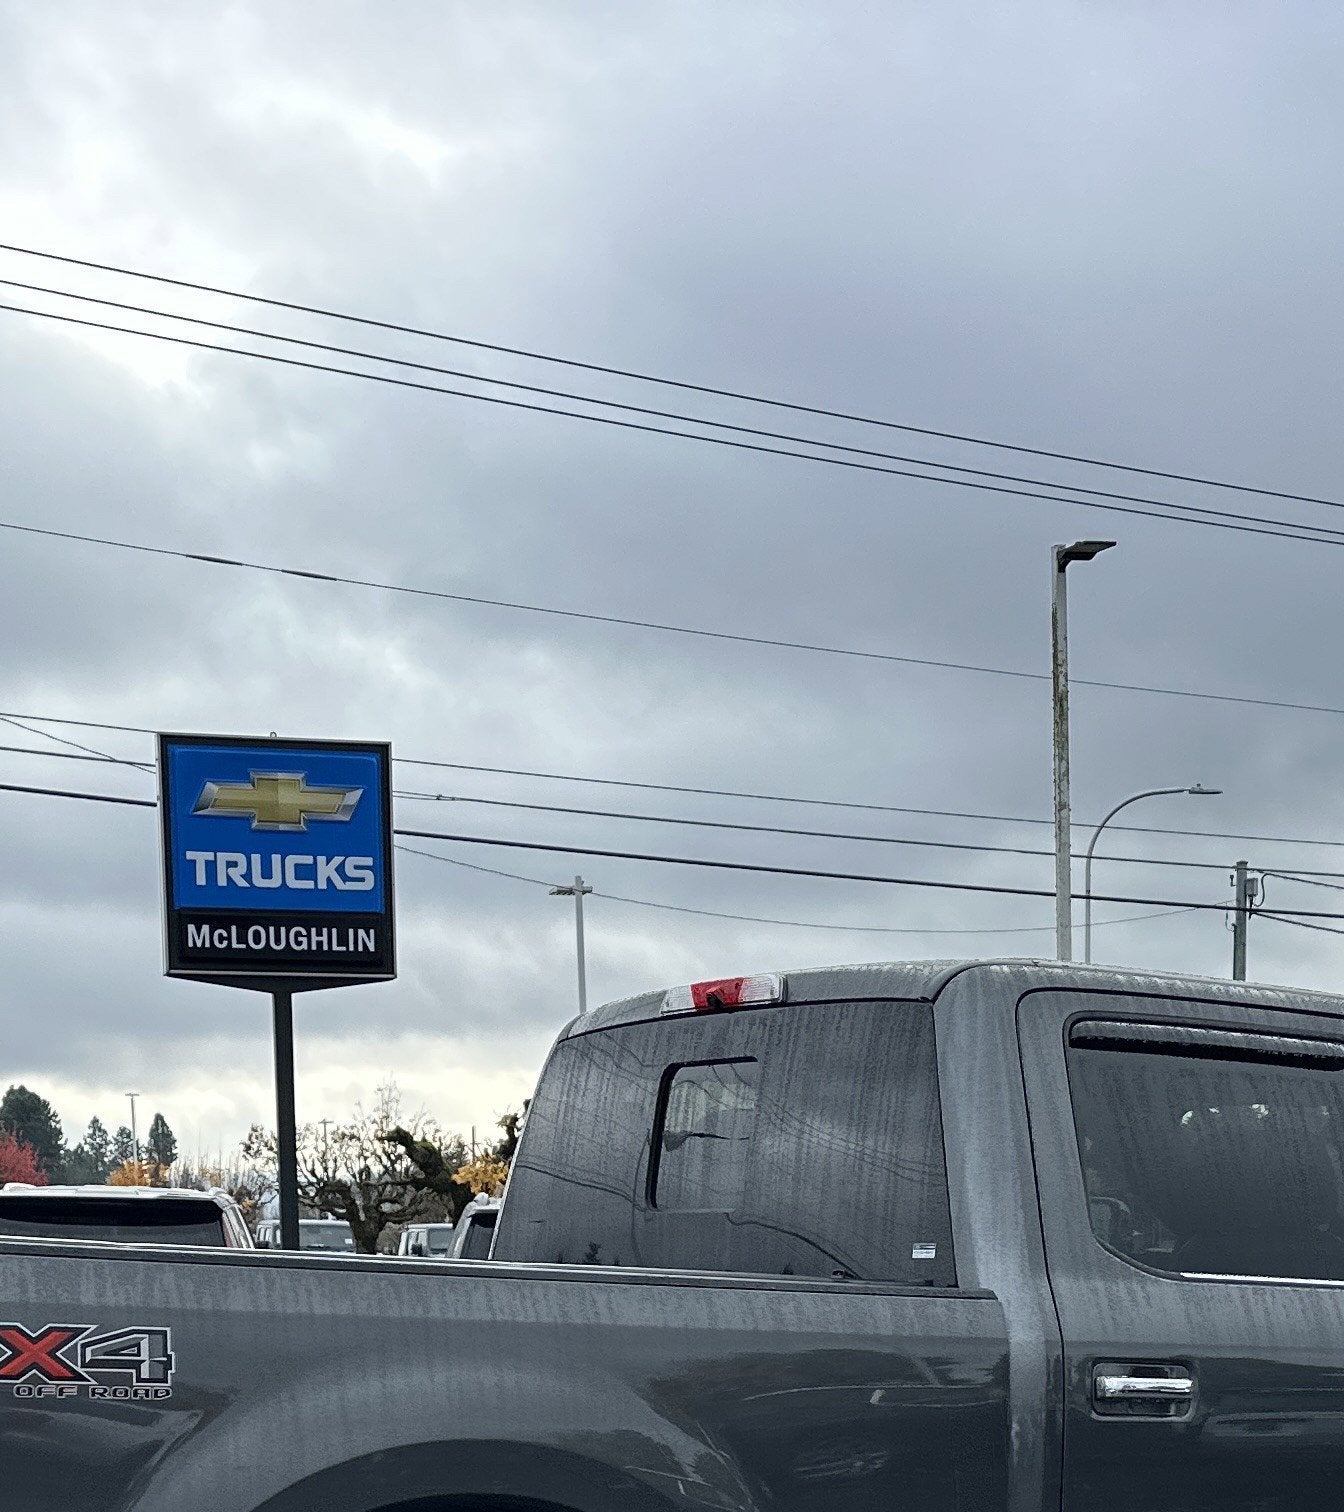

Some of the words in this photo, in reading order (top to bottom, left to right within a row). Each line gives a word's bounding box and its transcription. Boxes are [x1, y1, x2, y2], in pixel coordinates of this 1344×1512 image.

[185, 851, 375, 890] TRUCKS
[187, 923, 376, 952] McLOUGHLIN
[13, 1384, 78, 1399] OFF
[89, 1385, 173, 1400] ROAD
